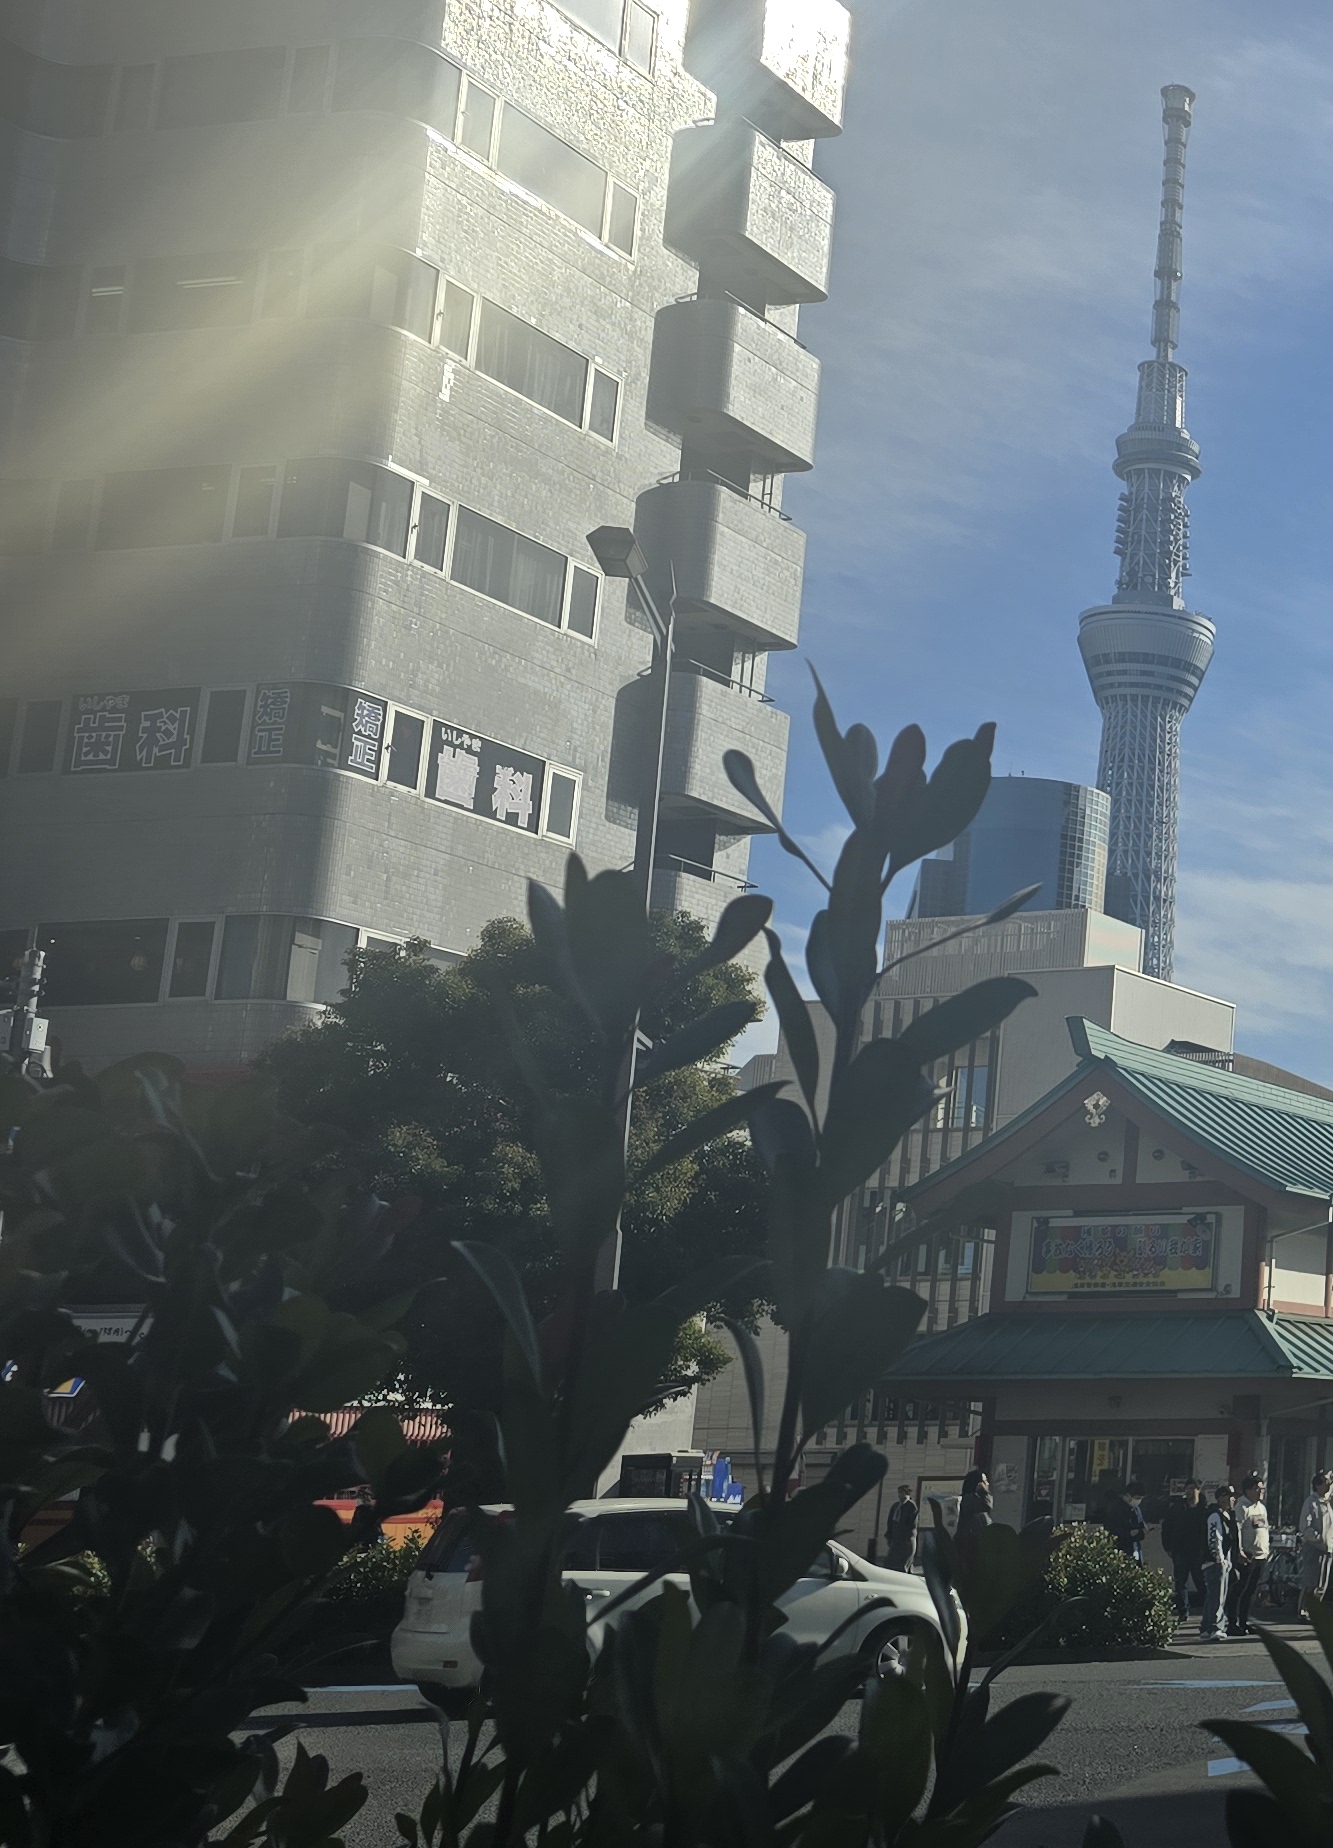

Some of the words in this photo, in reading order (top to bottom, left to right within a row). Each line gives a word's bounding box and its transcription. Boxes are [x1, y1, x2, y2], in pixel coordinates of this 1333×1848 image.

[71, 706, 190, 771] 歯科
[252, 689, 291, 758] 矯正
[348, 698, 383, 773] 矯正
[441, 727, 482, 752] いしやま
[435, 745, 533, 828] 歯科
